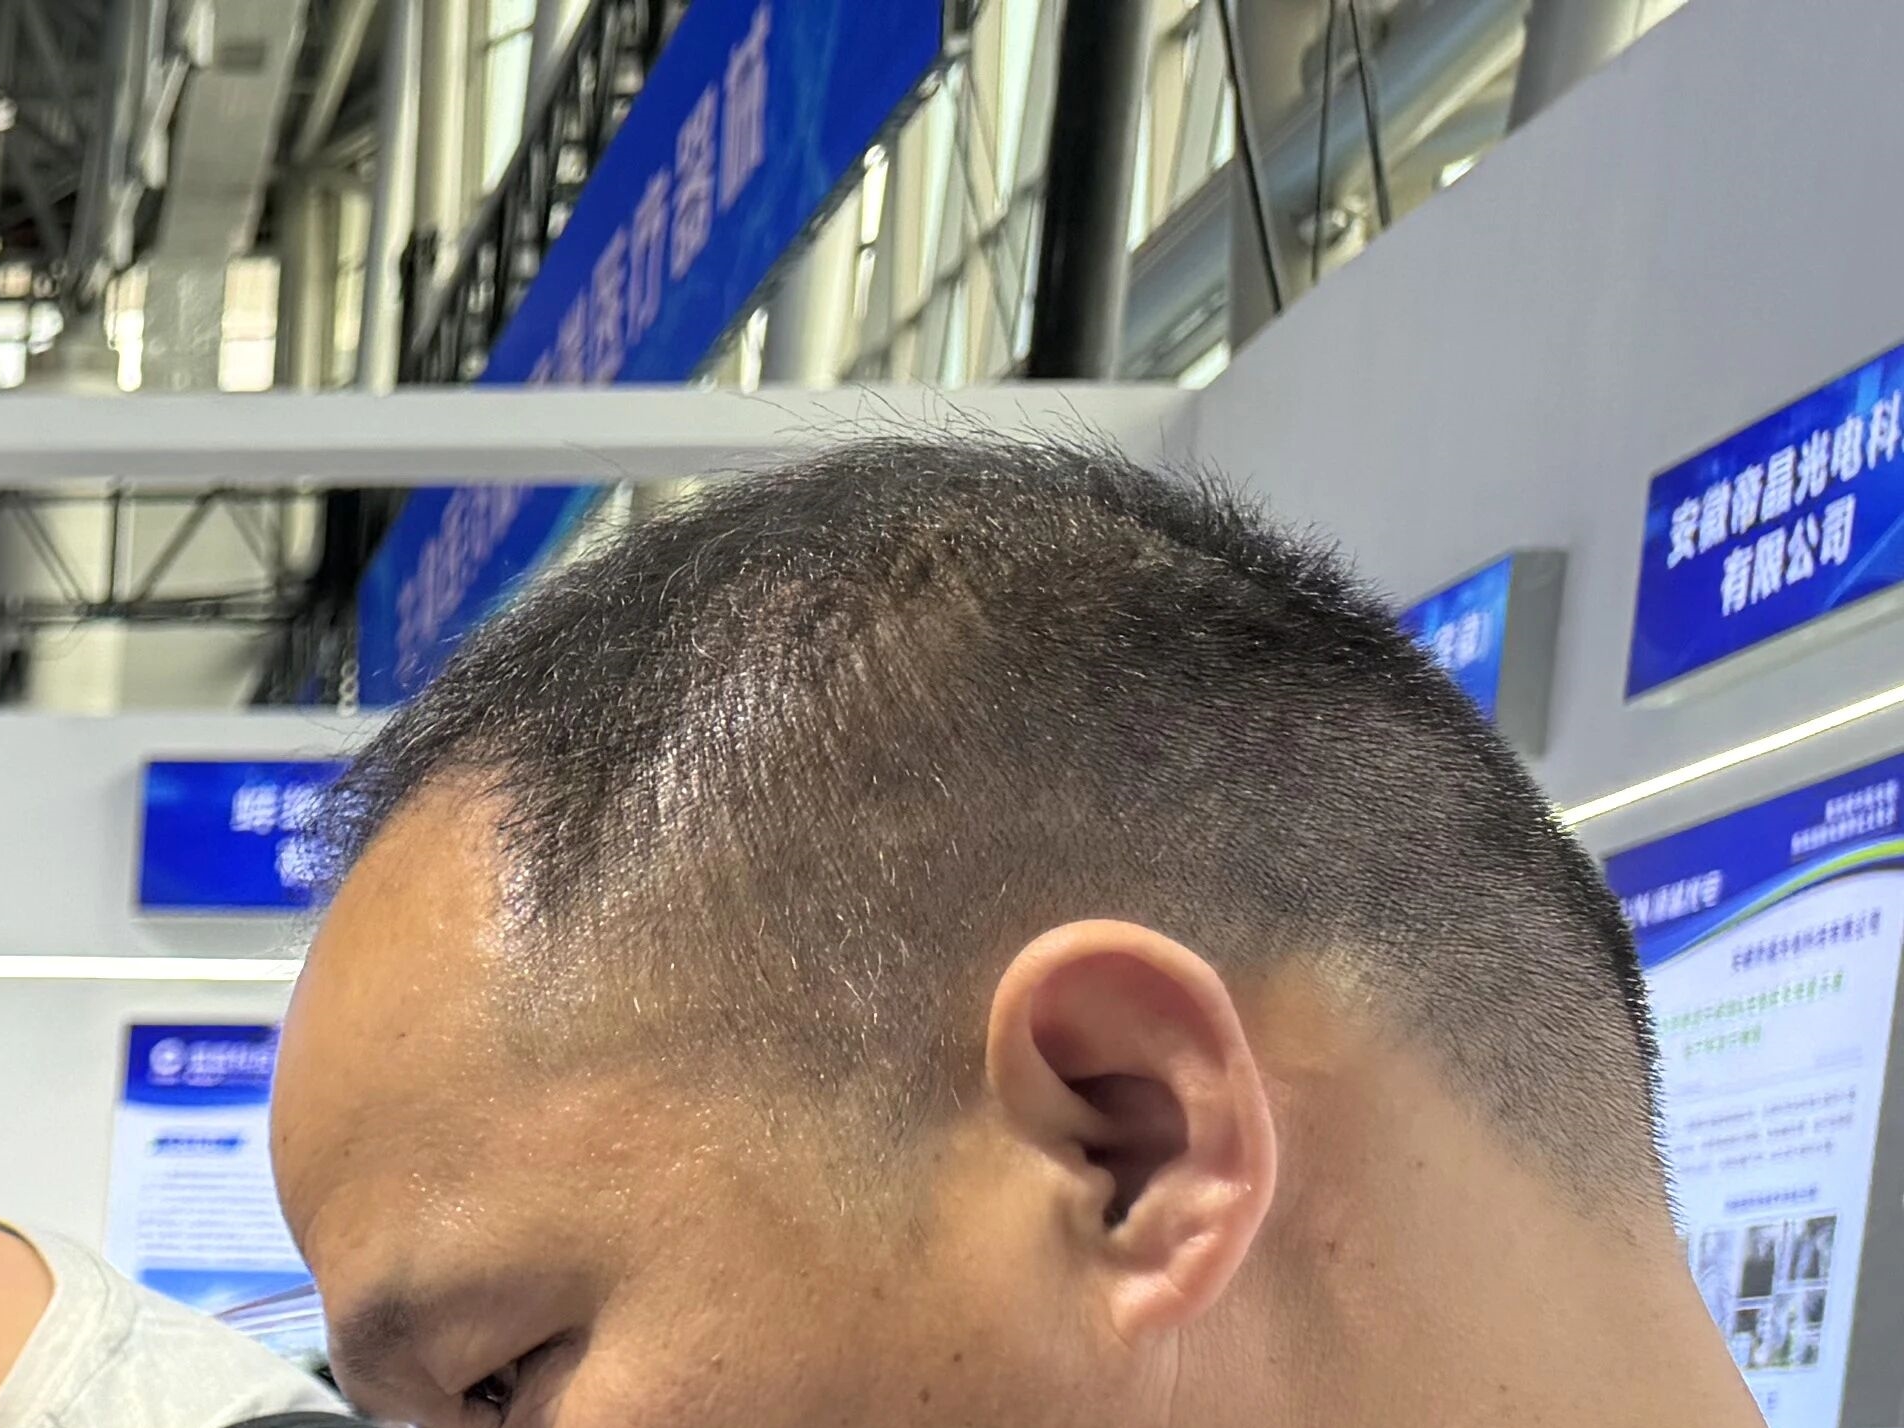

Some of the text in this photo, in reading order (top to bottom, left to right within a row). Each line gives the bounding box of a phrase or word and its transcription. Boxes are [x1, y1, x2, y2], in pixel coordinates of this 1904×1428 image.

[1667, 388, 1904, 570] 安徽帝晶光电科
[1720, 493, 1857, 618] 有限公司
